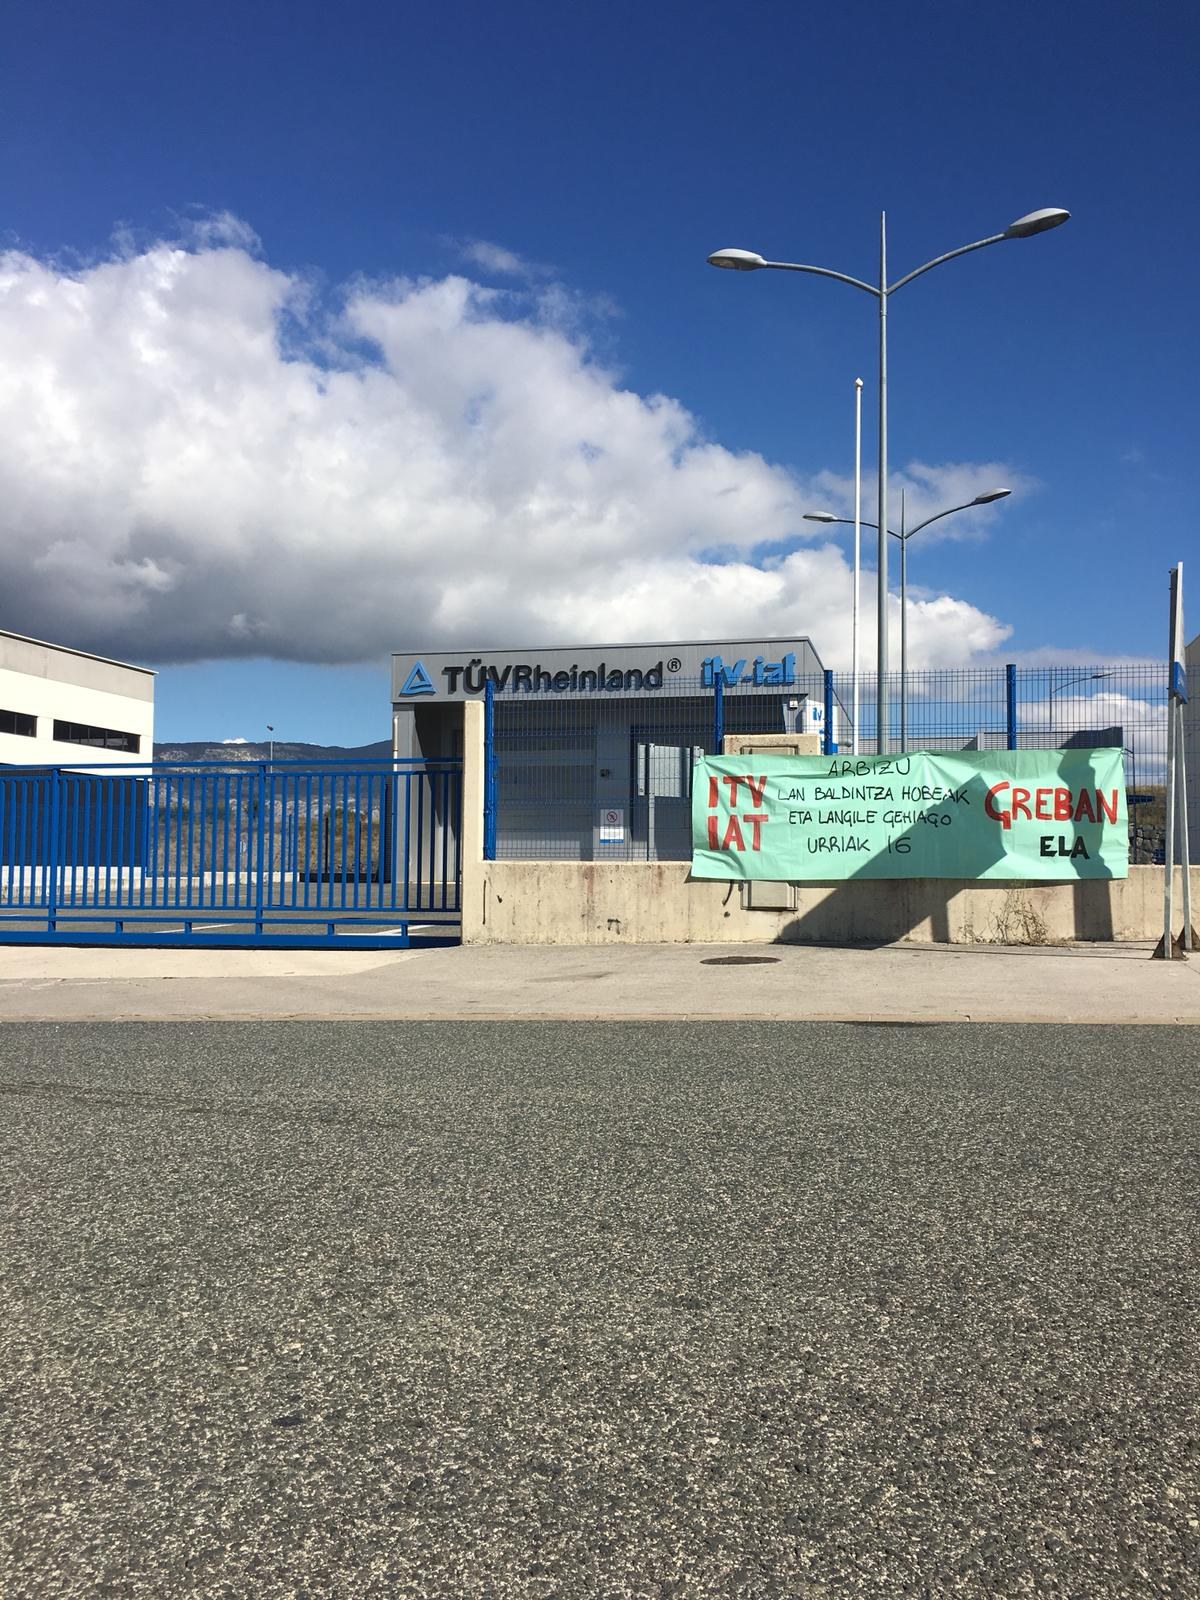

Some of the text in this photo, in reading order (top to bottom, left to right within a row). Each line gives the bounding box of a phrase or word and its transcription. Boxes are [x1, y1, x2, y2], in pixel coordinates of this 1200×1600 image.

[828, 758, 911, 777] ARBIZU
[708, 775, 767, 808] ITV
[777, 785, 970, 805] LAN BALDINTZA HOBEAK
[984, 781, 1119, 830] GREBAN
[788, 809, 952, 828] ETA LANGILE GEHIAGO
[707, 814, 769, 852] IAT
[807, 835, 911, 854] URRIAK 16
[1040, 835, 1090, 860] ELA
